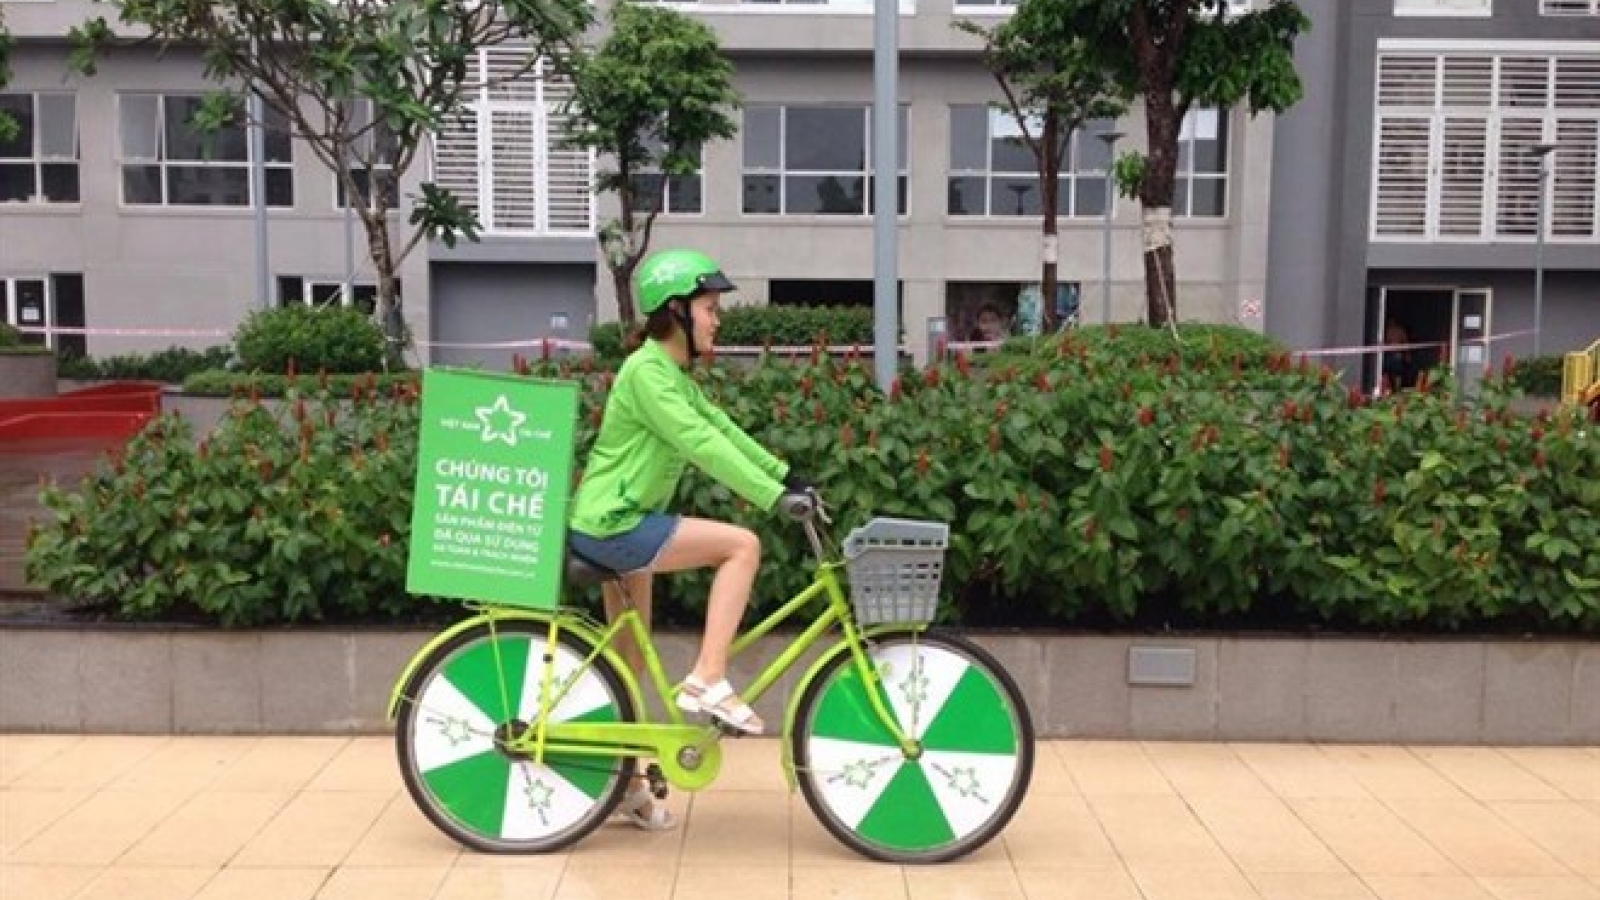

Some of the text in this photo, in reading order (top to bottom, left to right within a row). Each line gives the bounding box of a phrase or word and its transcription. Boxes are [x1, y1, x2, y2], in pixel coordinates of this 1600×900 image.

[435, 458, 549, 490] CHÚNG TÔI
[435, 482, 479, 511] TÁI
